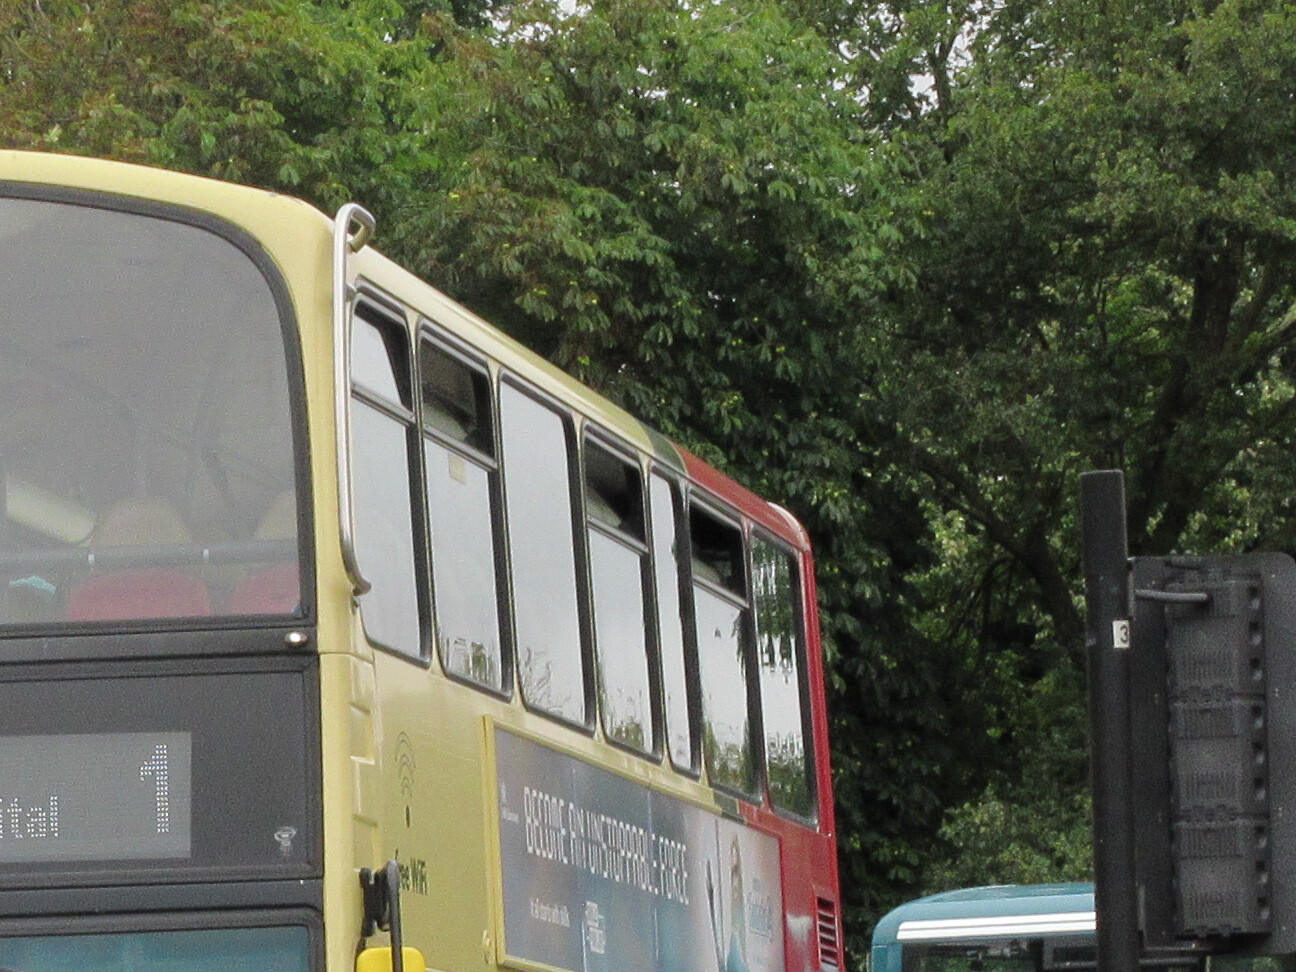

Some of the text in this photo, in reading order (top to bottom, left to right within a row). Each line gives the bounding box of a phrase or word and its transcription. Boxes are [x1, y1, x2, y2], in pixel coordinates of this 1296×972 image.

[139, 744, 169, 832] 1
[524, 786, 568, 864] BECOME
[568, 802, 586, 869] AN
[659, 836, 689, 905] FORCE
